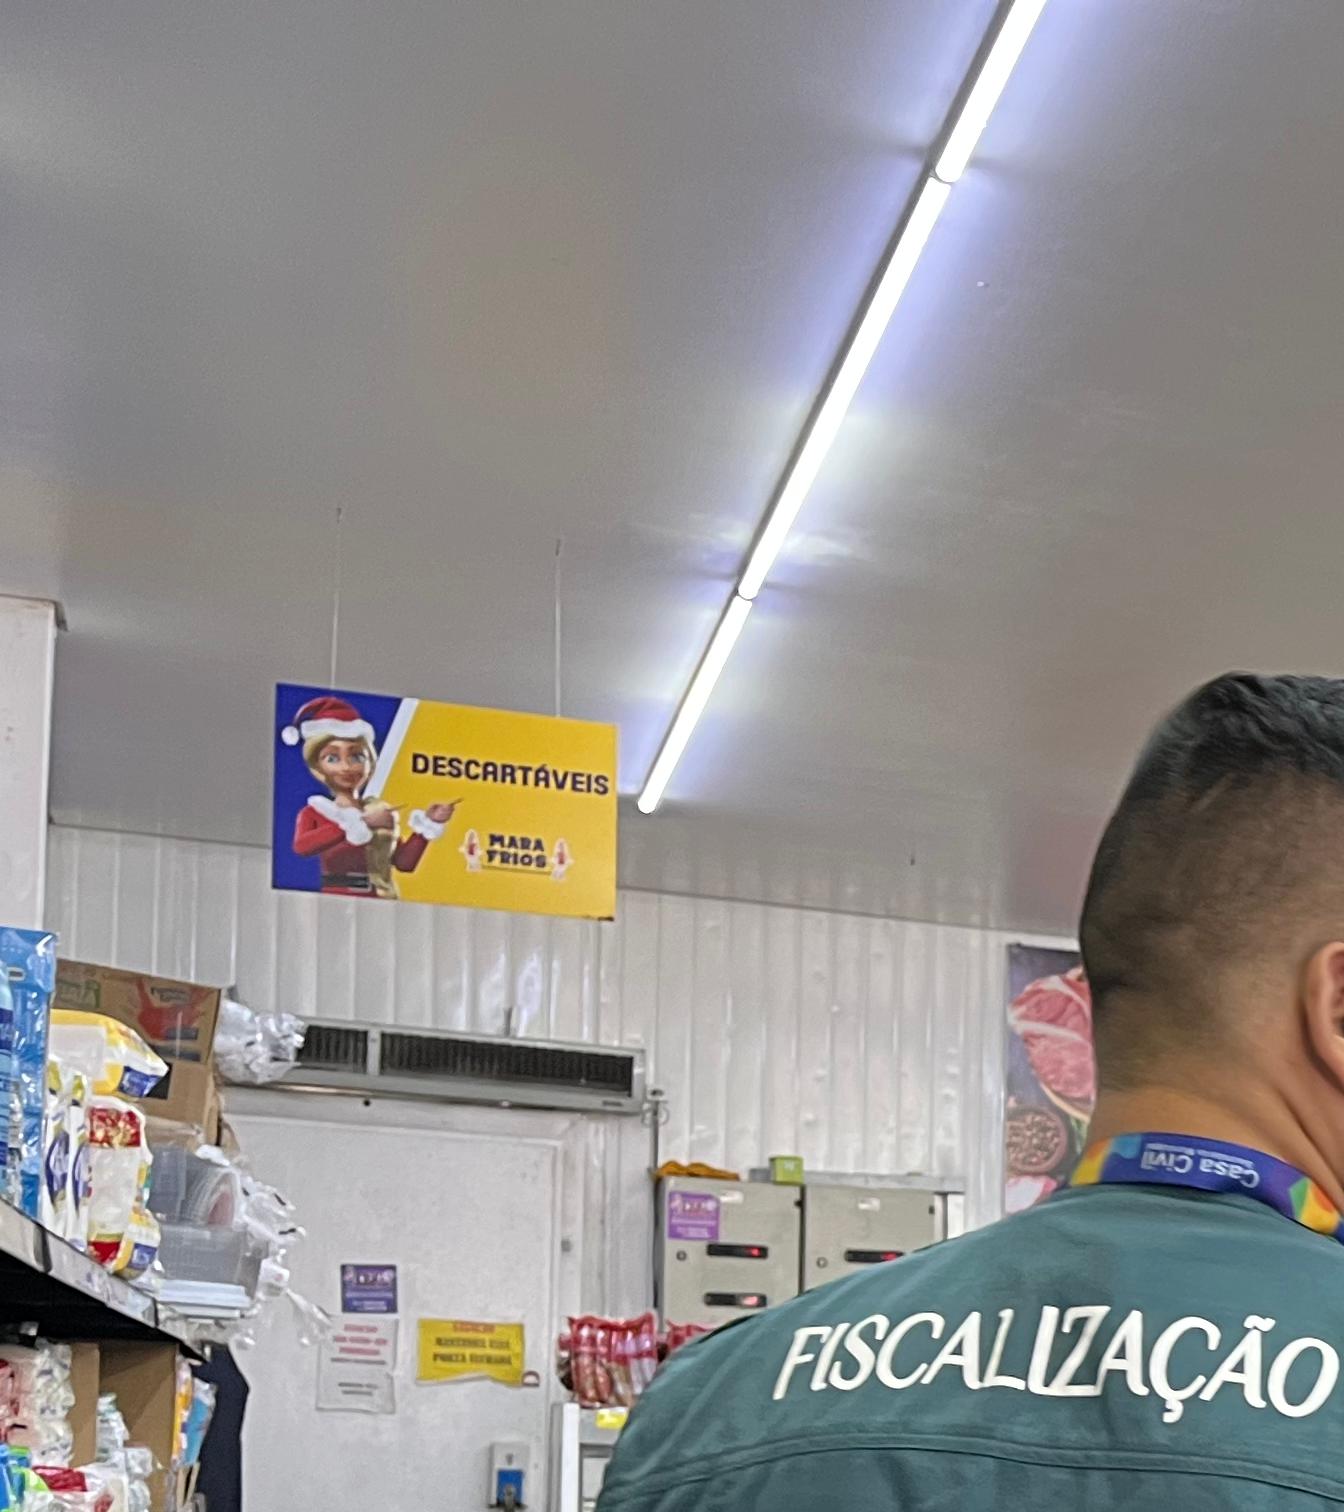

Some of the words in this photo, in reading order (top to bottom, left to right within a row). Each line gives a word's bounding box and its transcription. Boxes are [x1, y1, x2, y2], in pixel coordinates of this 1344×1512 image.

[412, 752, 609, 795] DESCARTÁVEIS
[486, 850, 547, 868] FRIOS
[1140, 1148, 1193, 1175] Civil
[1199, 1160, 1261, 1188] Casa
[773, 1305, 1340, 1423] FISCALIZAÇÃO
